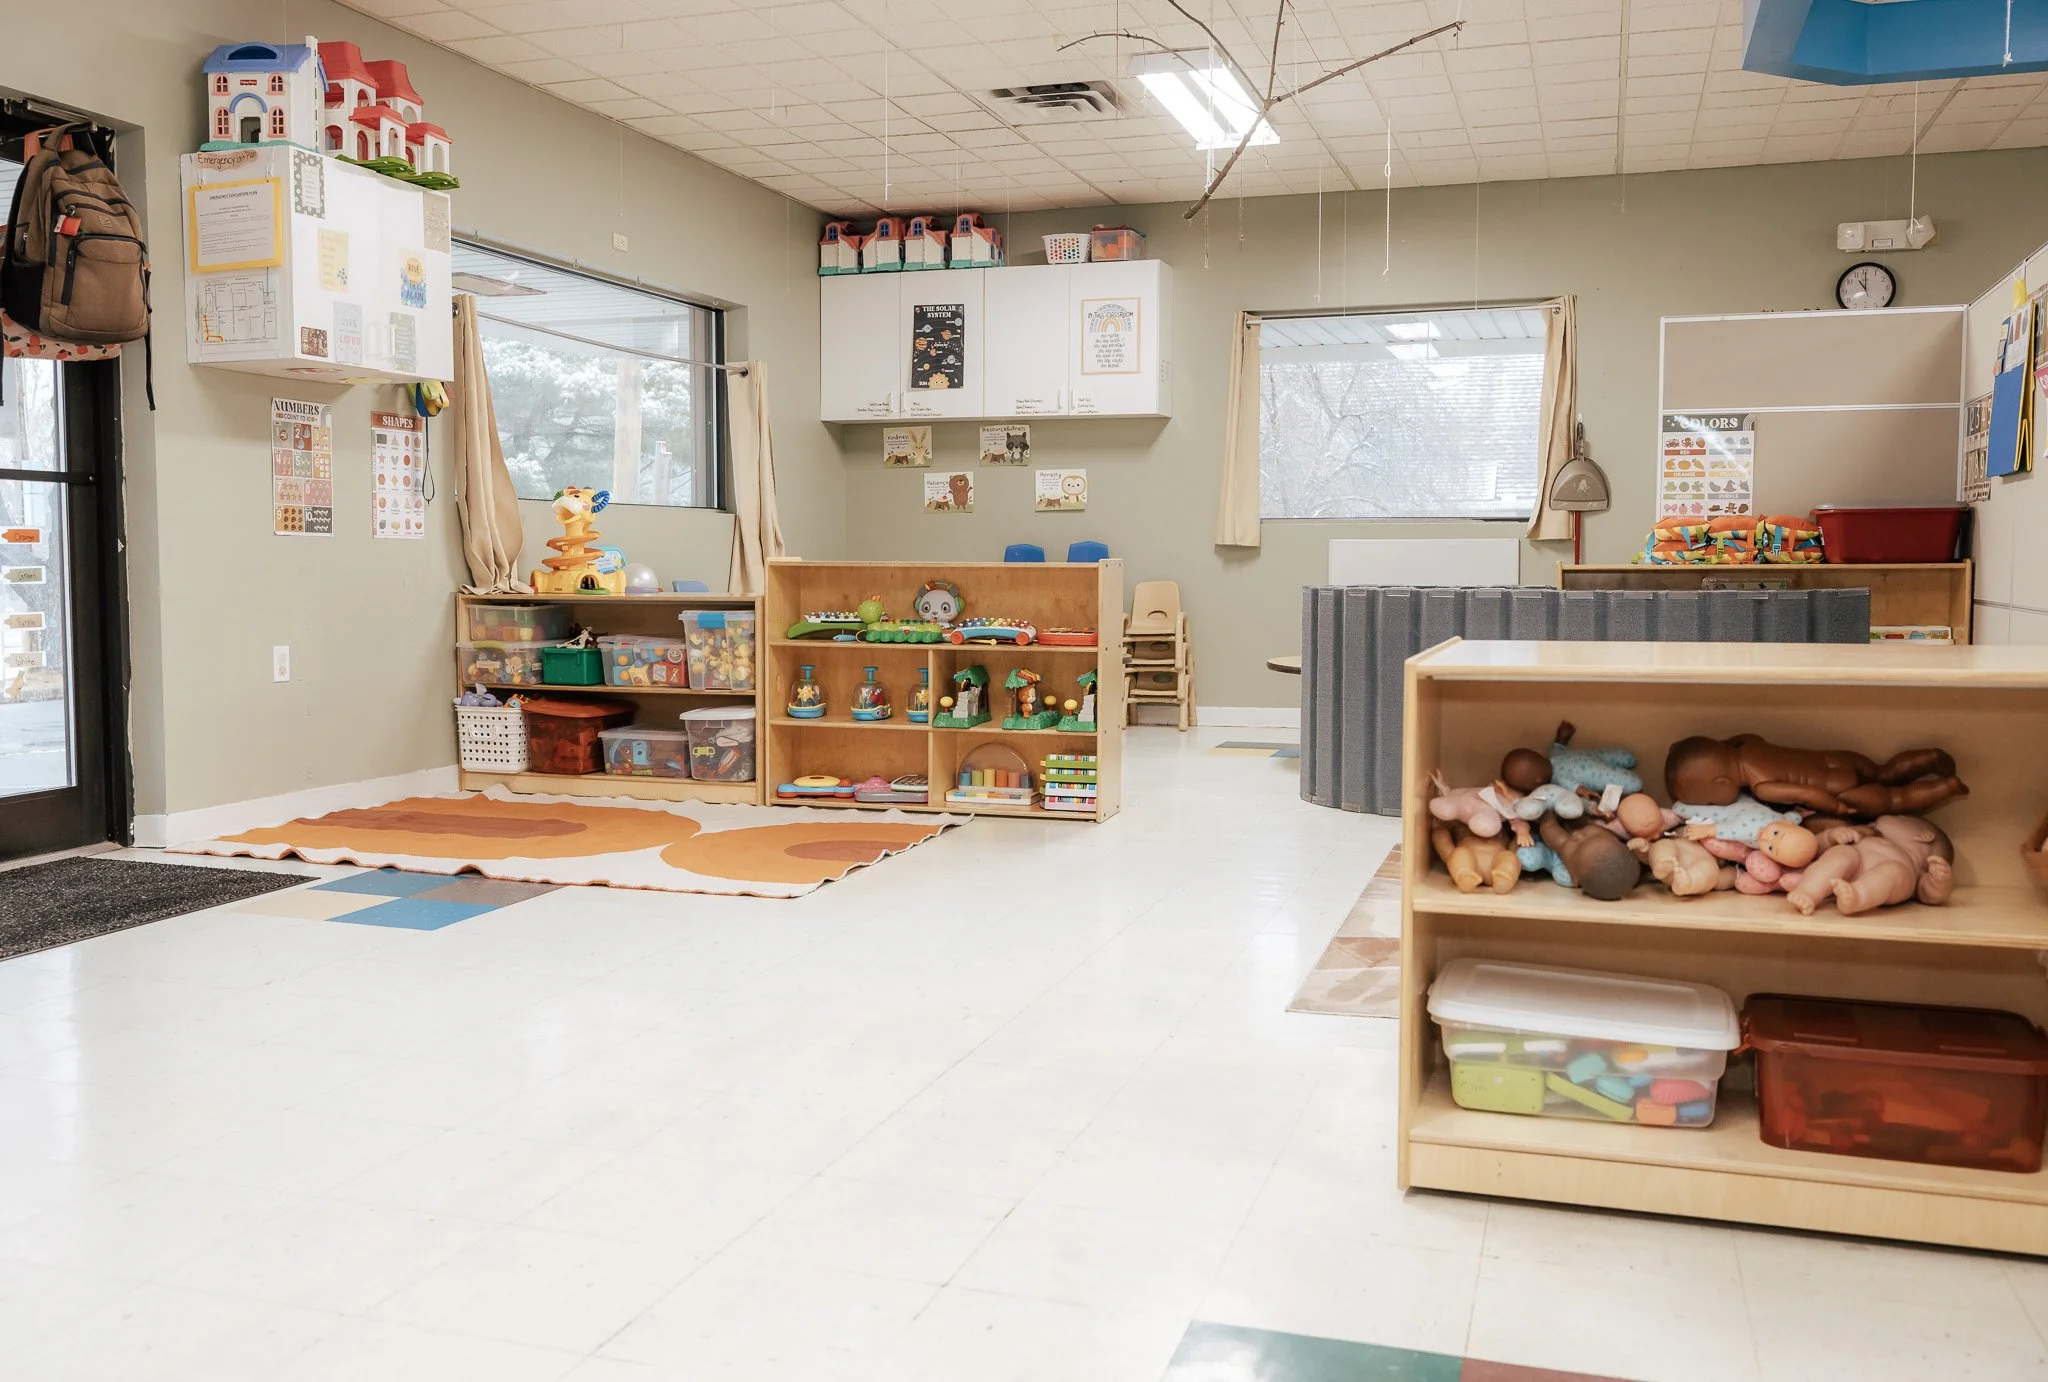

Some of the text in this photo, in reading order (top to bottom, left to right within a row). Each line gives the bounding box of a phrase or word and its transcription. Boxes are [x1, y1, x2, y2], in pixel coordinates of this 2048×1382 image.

[197, 153, 236, 170] Emergency
[407, 263, 420, 274] RISE
[273, 400, 320, 416] NUMBERS
[382, 415, 414, 429] SHAPES
[1679, 416, 1739, 430] COLORS
[295, 428, 301, 439] 2
[276, 453, 282, 464] 4
[295, 454, 300, 466] 5
[315, 457, 320, 468] 6
[305, 484, 311, 494] 8
[276, 510, 282, 520] 9
[305, 511, 312, 522] 10
[15, 532, 35, 542] Orange
[18, 570, 37, 581] Green
[16, 655, 36, 666] White
